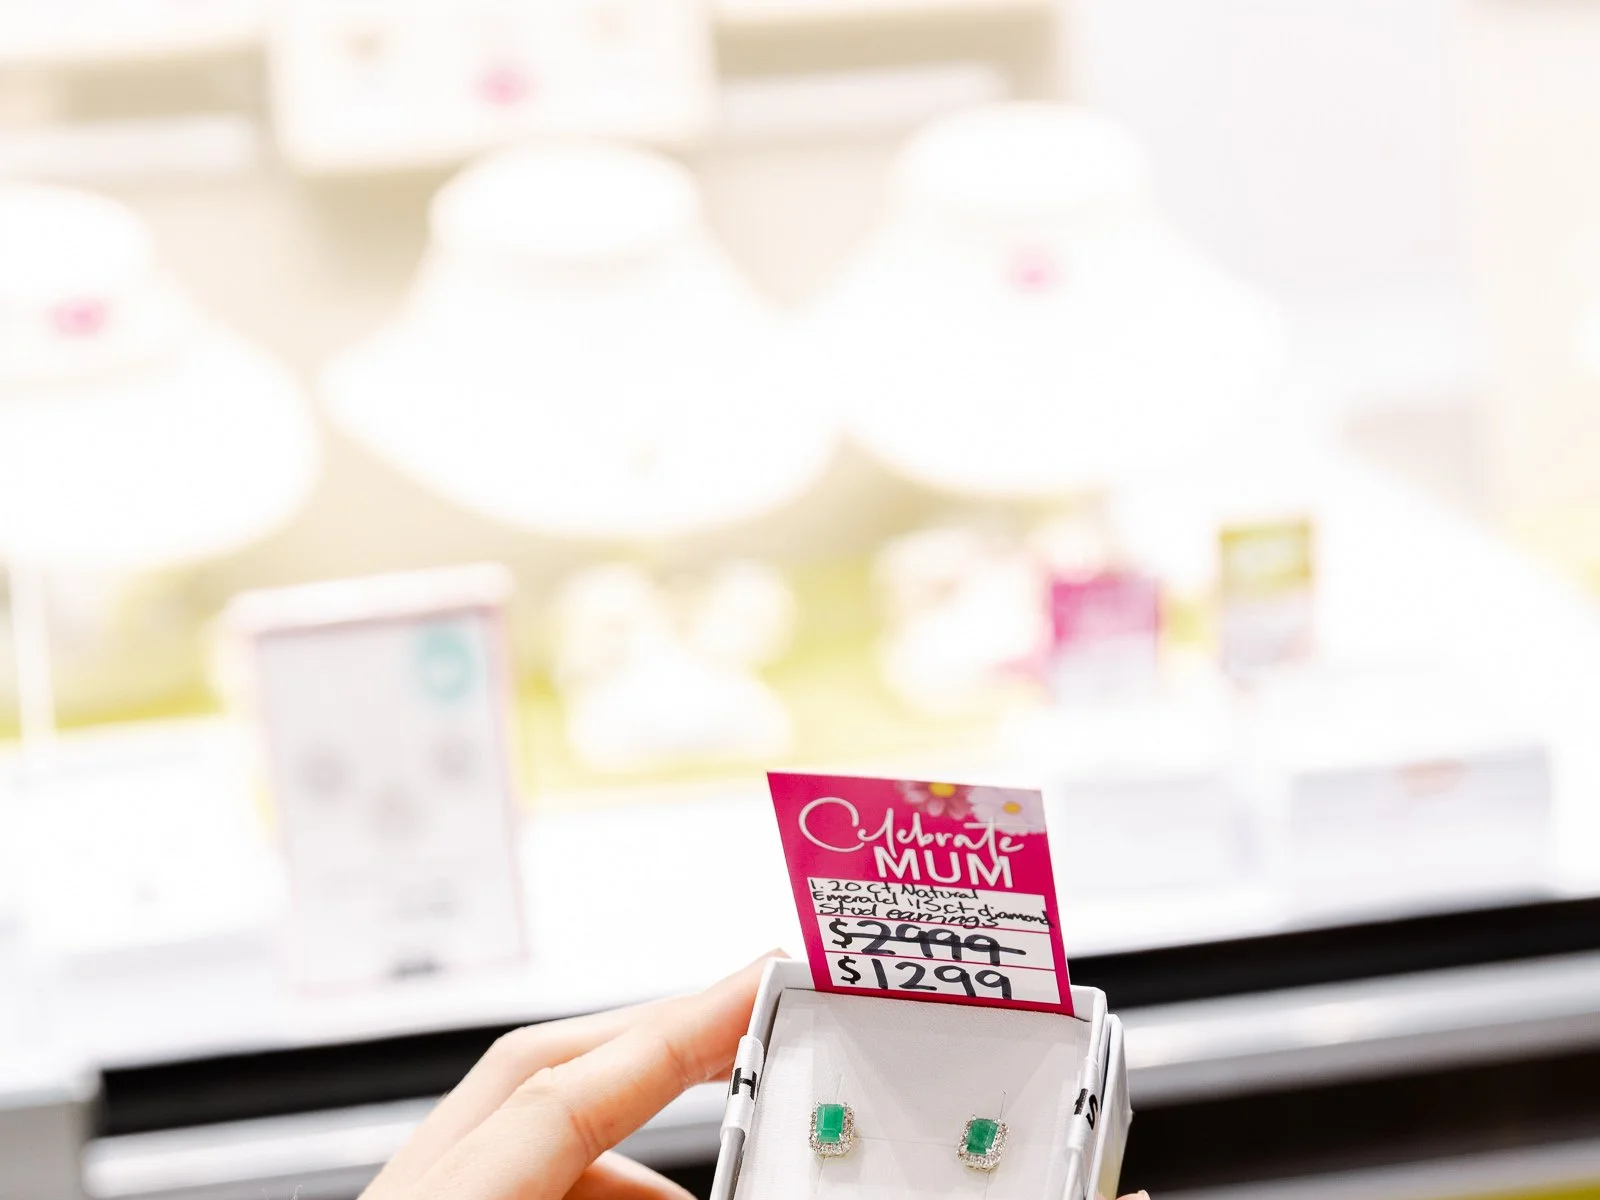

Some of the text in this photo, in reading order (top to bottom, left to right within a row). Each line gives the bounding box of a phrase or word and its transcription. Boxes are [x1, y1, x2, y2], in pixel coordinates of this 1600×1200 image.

[799, 797, 1024, 862] Celebrate
[873, 846, 1014, 888] MUM
[812, 891, 898, 905] Emerald
[978, 904, 1054, 928] diamond
[819, 901, 877, 916] Stud
[901, 883, 979, 899] Natural
[829, 917, 1004, 966] $2999
[837, 955, 1013, 1000] $1299
